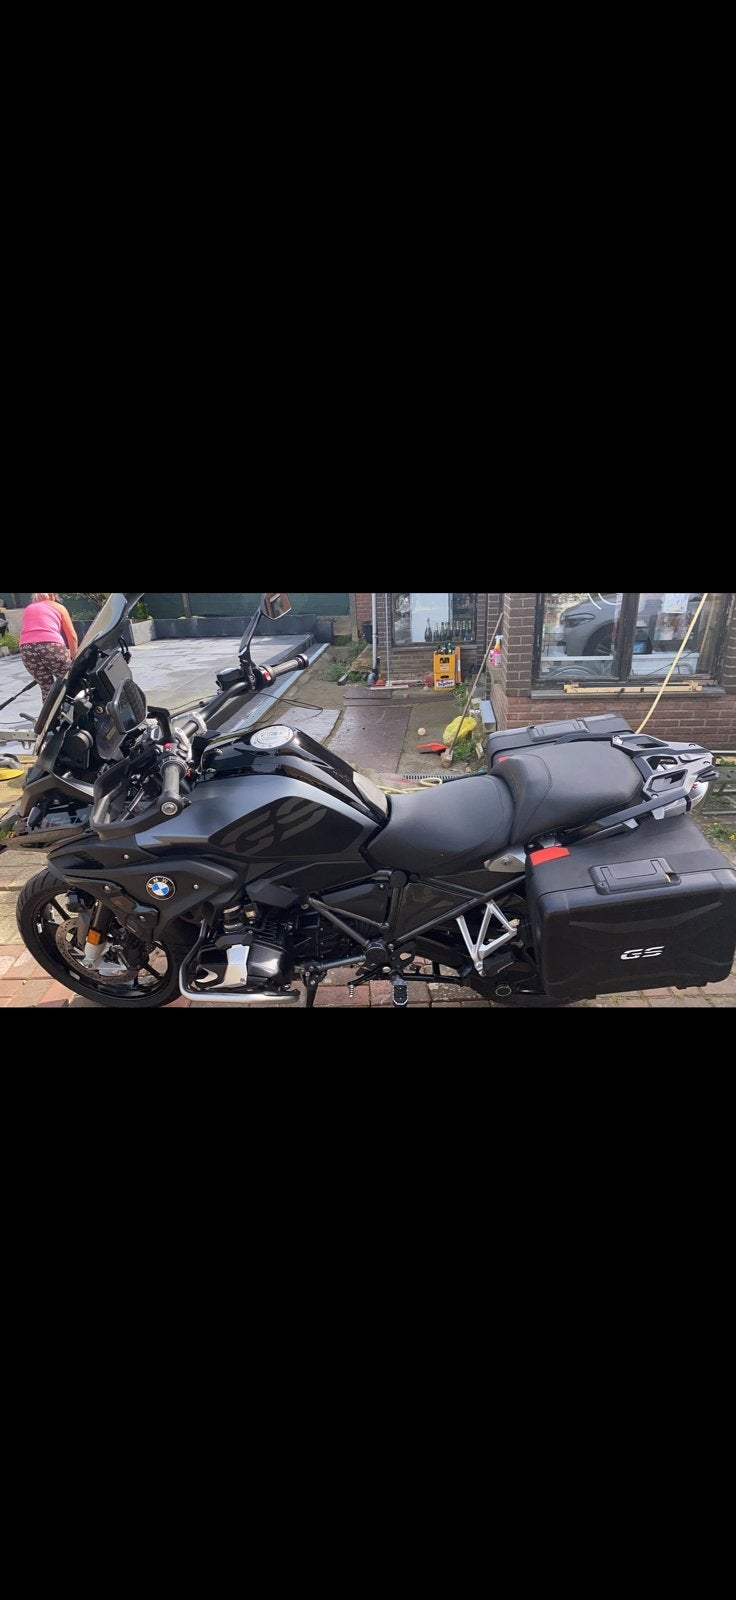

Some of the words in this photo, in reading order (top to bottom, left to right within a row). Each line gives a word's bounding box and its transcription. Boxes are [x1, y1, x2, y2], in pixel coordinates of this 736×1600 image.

[220, 797, 327, 856] GS
[148, 877, 168, 889] BMW
[620, 946, 664, 960] GS
